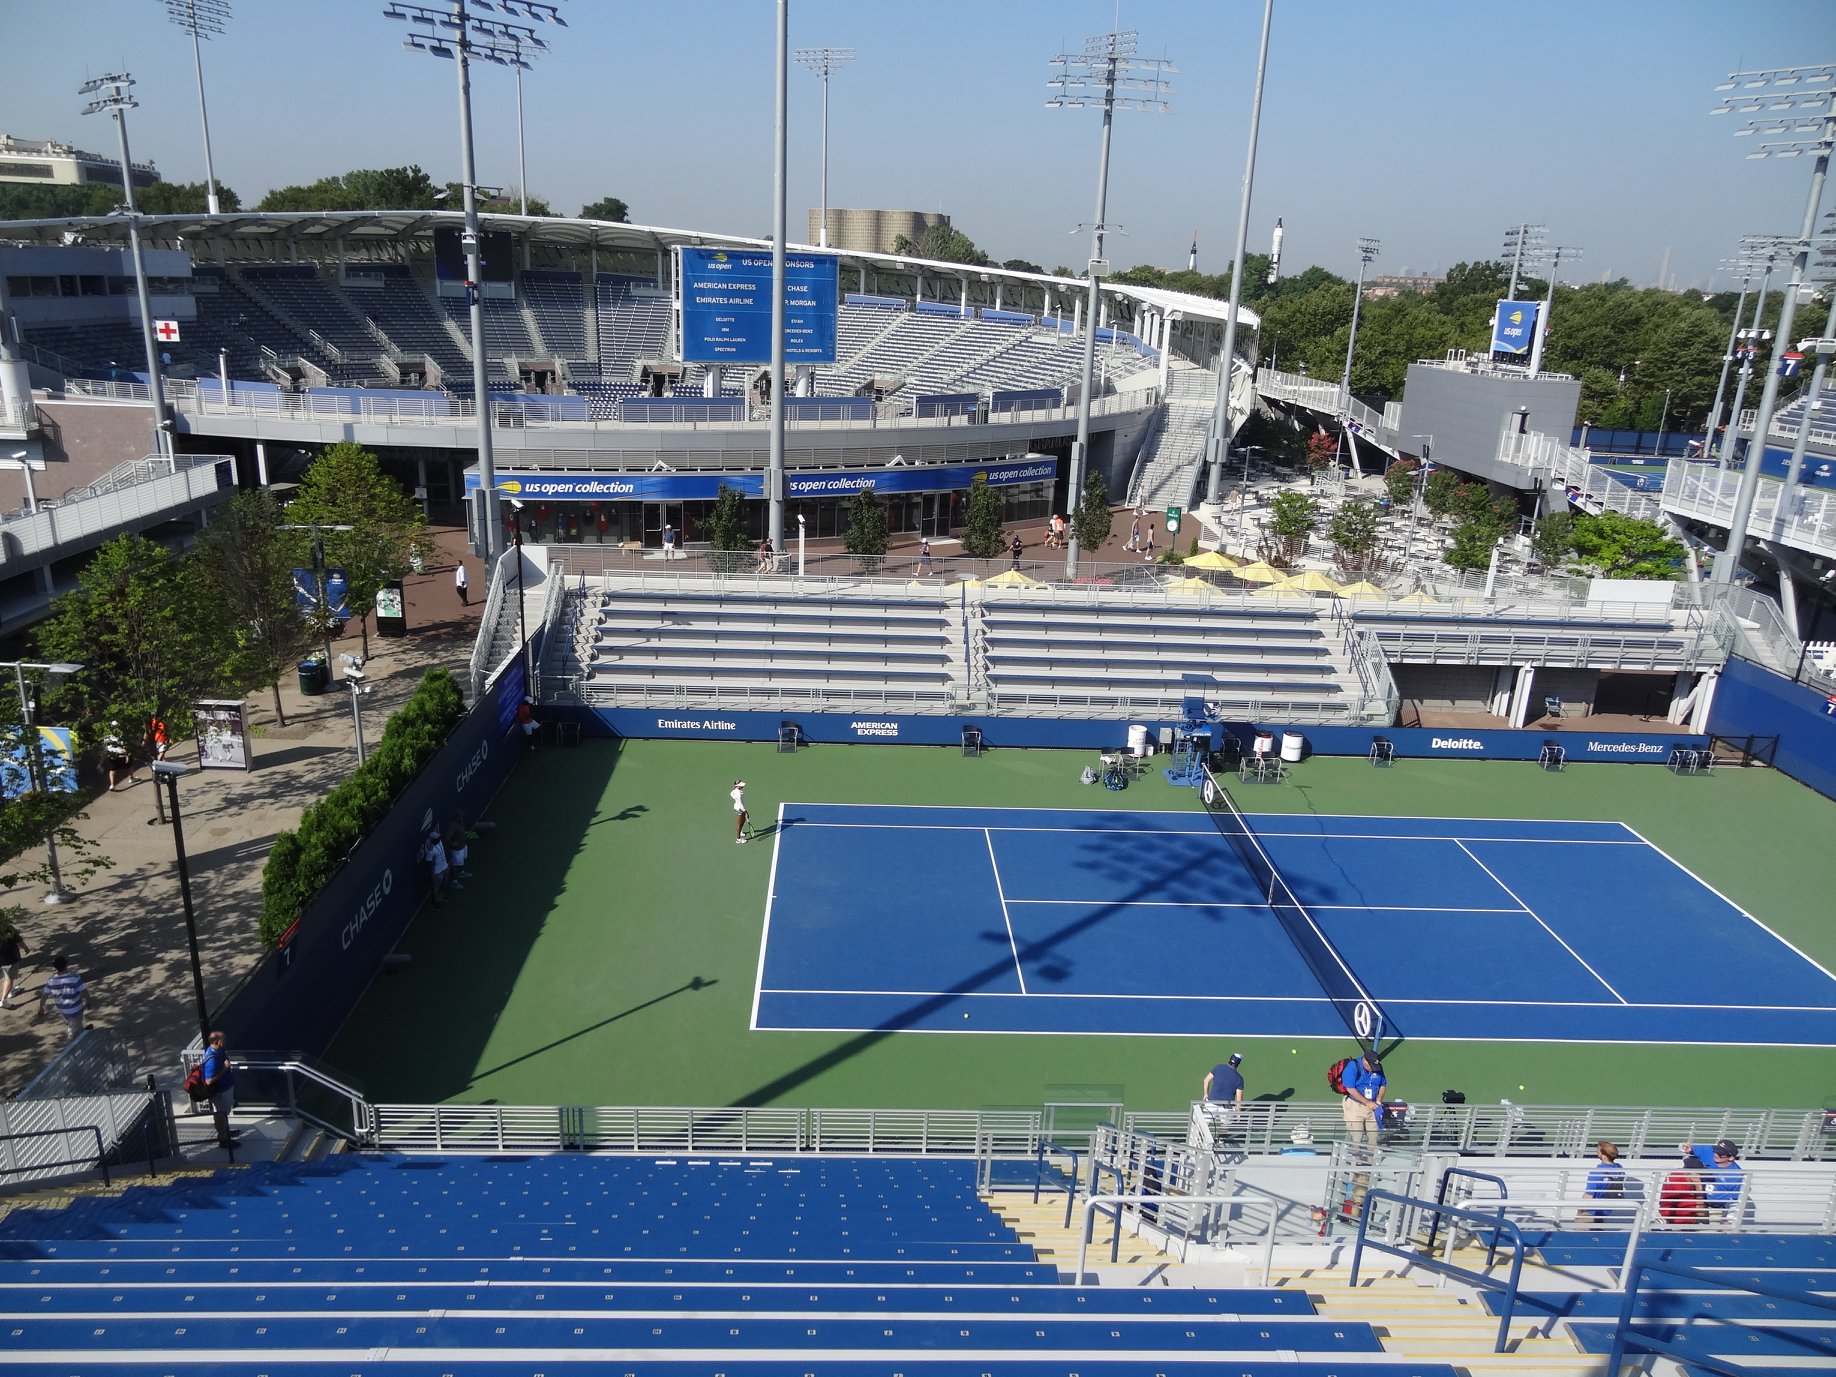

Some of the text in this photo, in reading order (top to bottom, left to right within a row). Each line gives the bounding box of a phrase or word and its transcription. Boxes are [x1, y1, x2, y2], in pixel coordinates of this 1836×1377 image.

[716, 263, 732, 271] open
[753, 259, 773, 267] OPEN
[785, 261, 815, 269] ONSORS
[693, 282, 756, 291] AMERICAN EXPRESS
[696, 296, 754, 305] EMIRATES AIRLINE
[1748, 352, 1754, 360] 5
[1785, 360, 1796, 376] 7
[989, 465, 1052, 482] us open collection
[525, 481, 634, 495] us open collection
[799, 481, 827, 493] open
[827, 477, 876, 490] collection
[1827, 703, 1835, 715] 7
[657, 719, 736, 730] Emirates Airline
[850, 721, 898, 730] AMERICAN
[857, 728, 899, 736] EXPRESS
[1431, 738, 1483, 750] Deloitte.
[1587, 741, 1664, 753] Mercedes-Benz
[456, 748, 482, 793] CHASE
[341, 883, 383, 951] CHASE
[284, 946, 291, 966] 7
